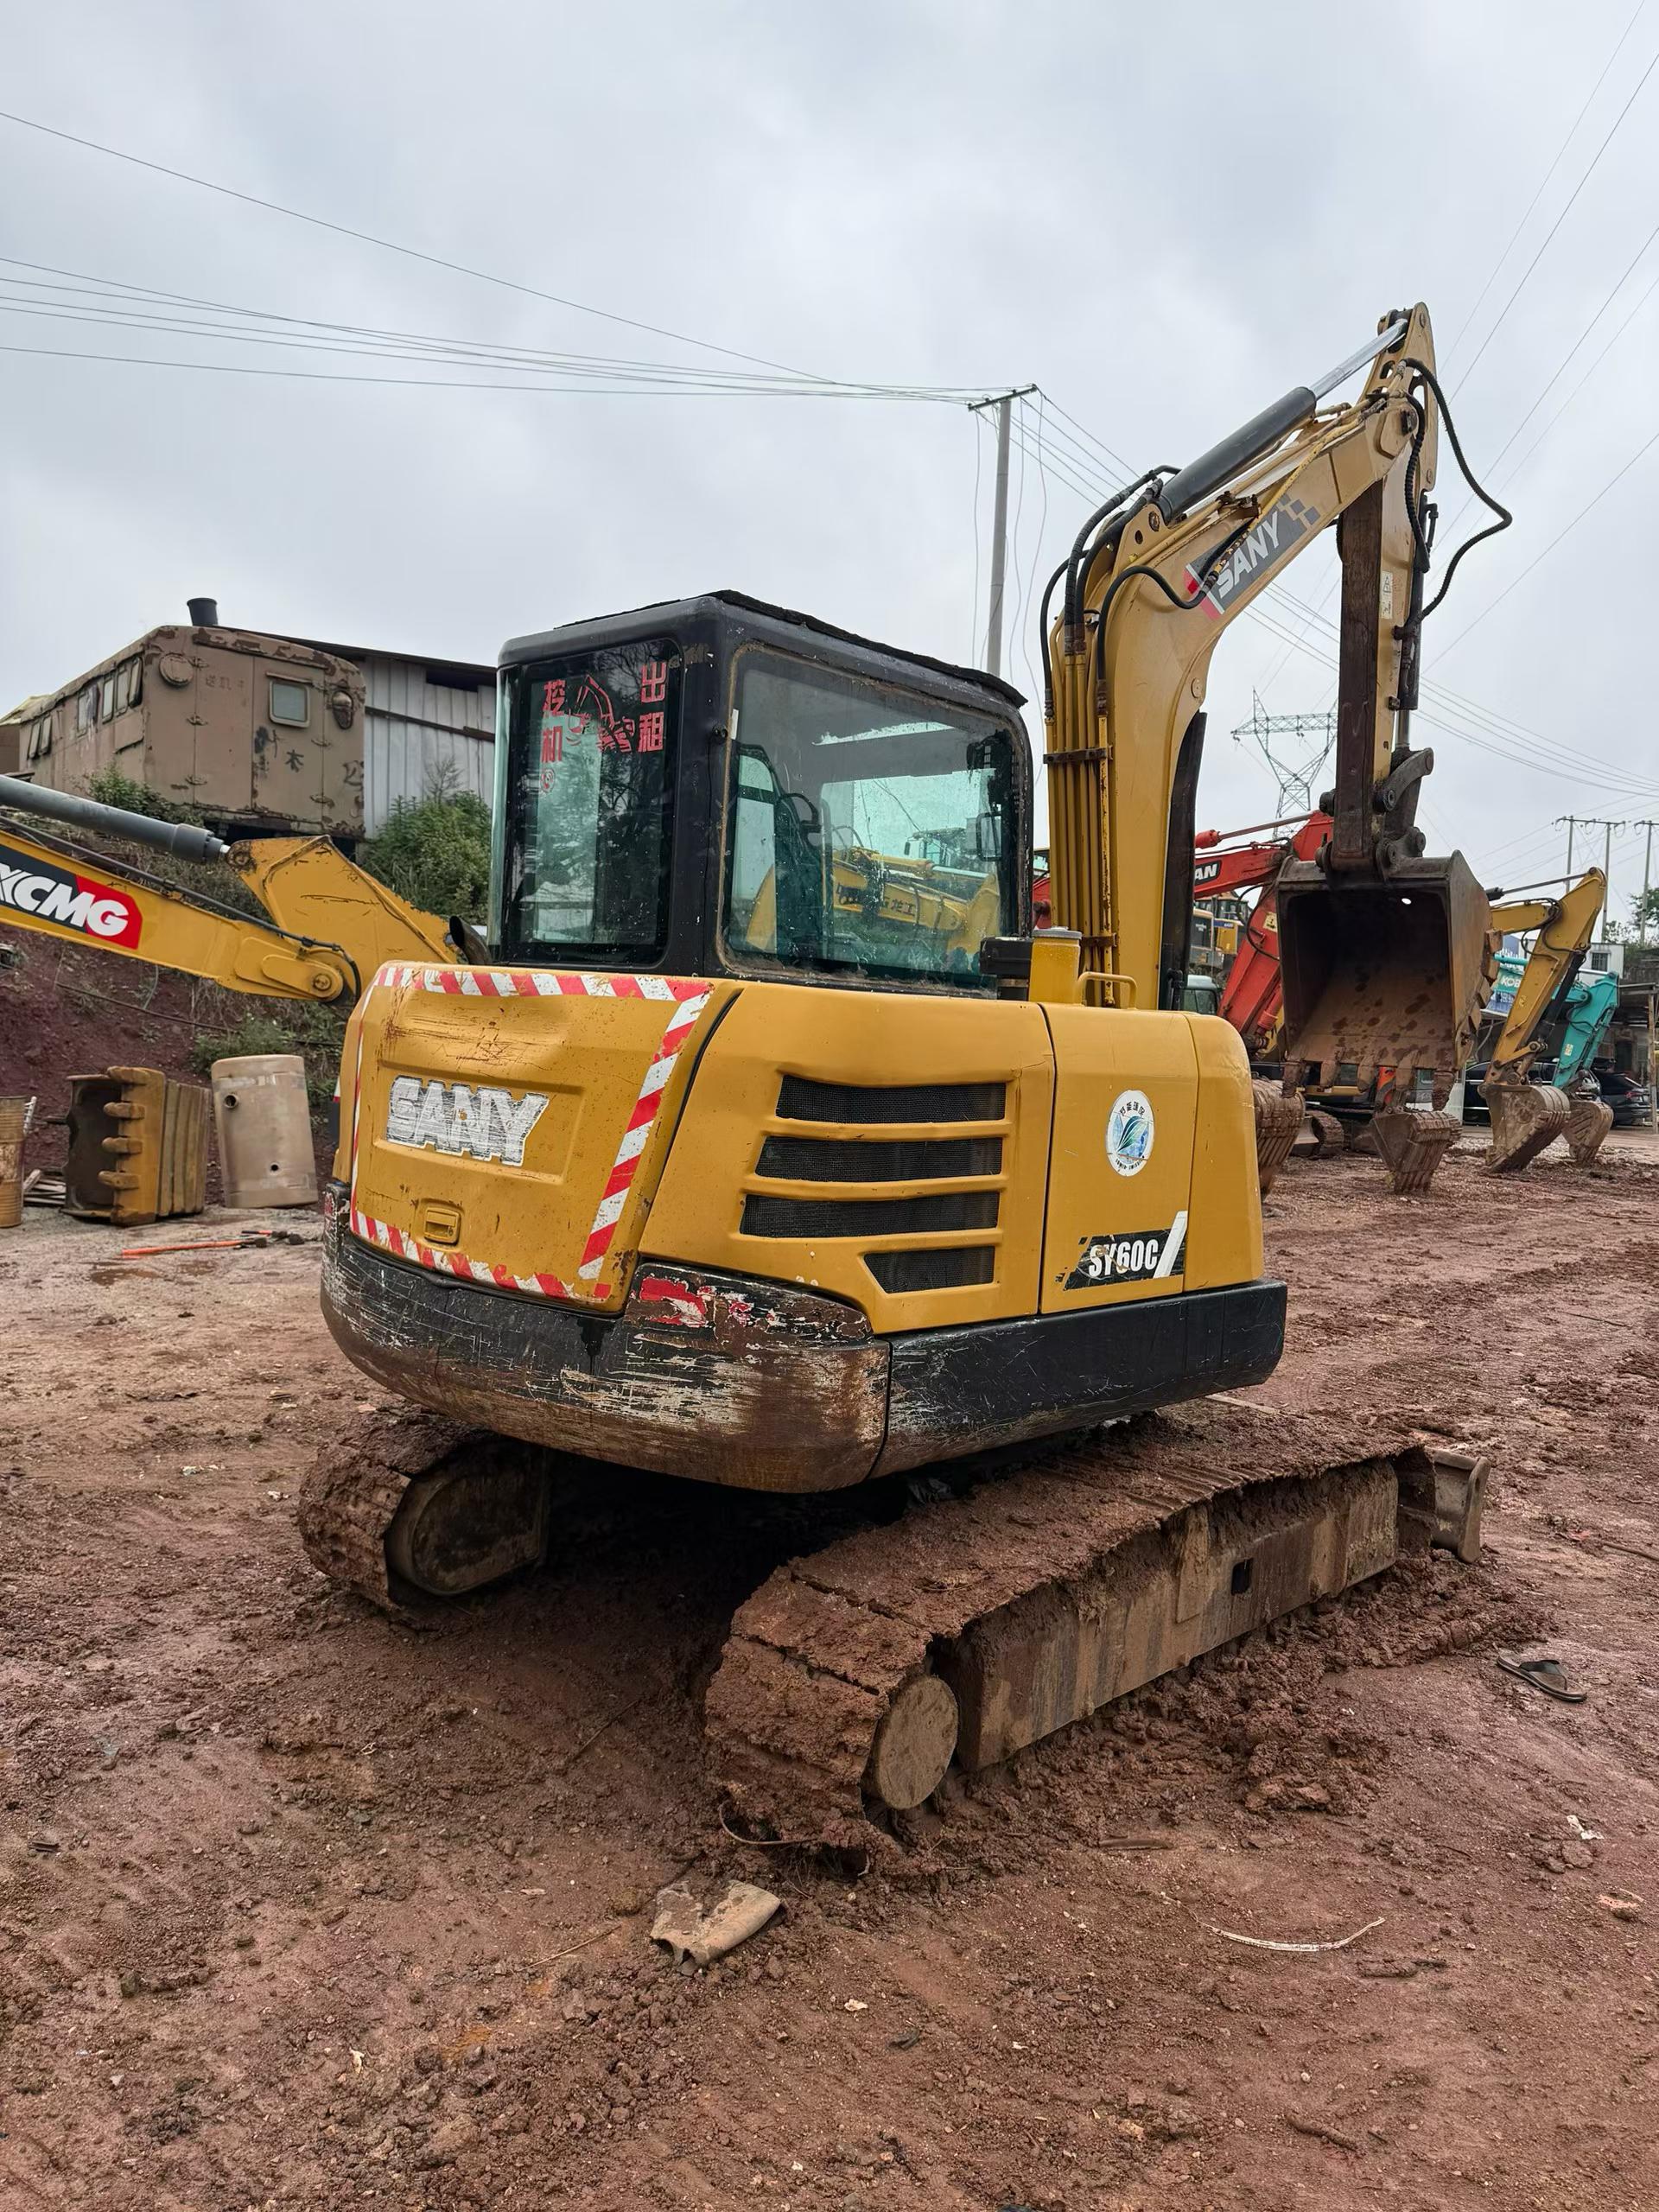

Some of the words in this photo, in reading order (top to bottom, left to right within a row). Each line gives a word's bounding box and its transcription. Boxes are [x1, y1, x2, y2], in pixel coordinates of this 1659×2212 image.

[1218, 512, 1279, 599] SANY
[541, 679, 566, 764] 挖机
[639, 662, 667, 753] 出租
[0, 864, 129, 937] XCMG
[1088, 1238, 1160, 1278] SY60C
